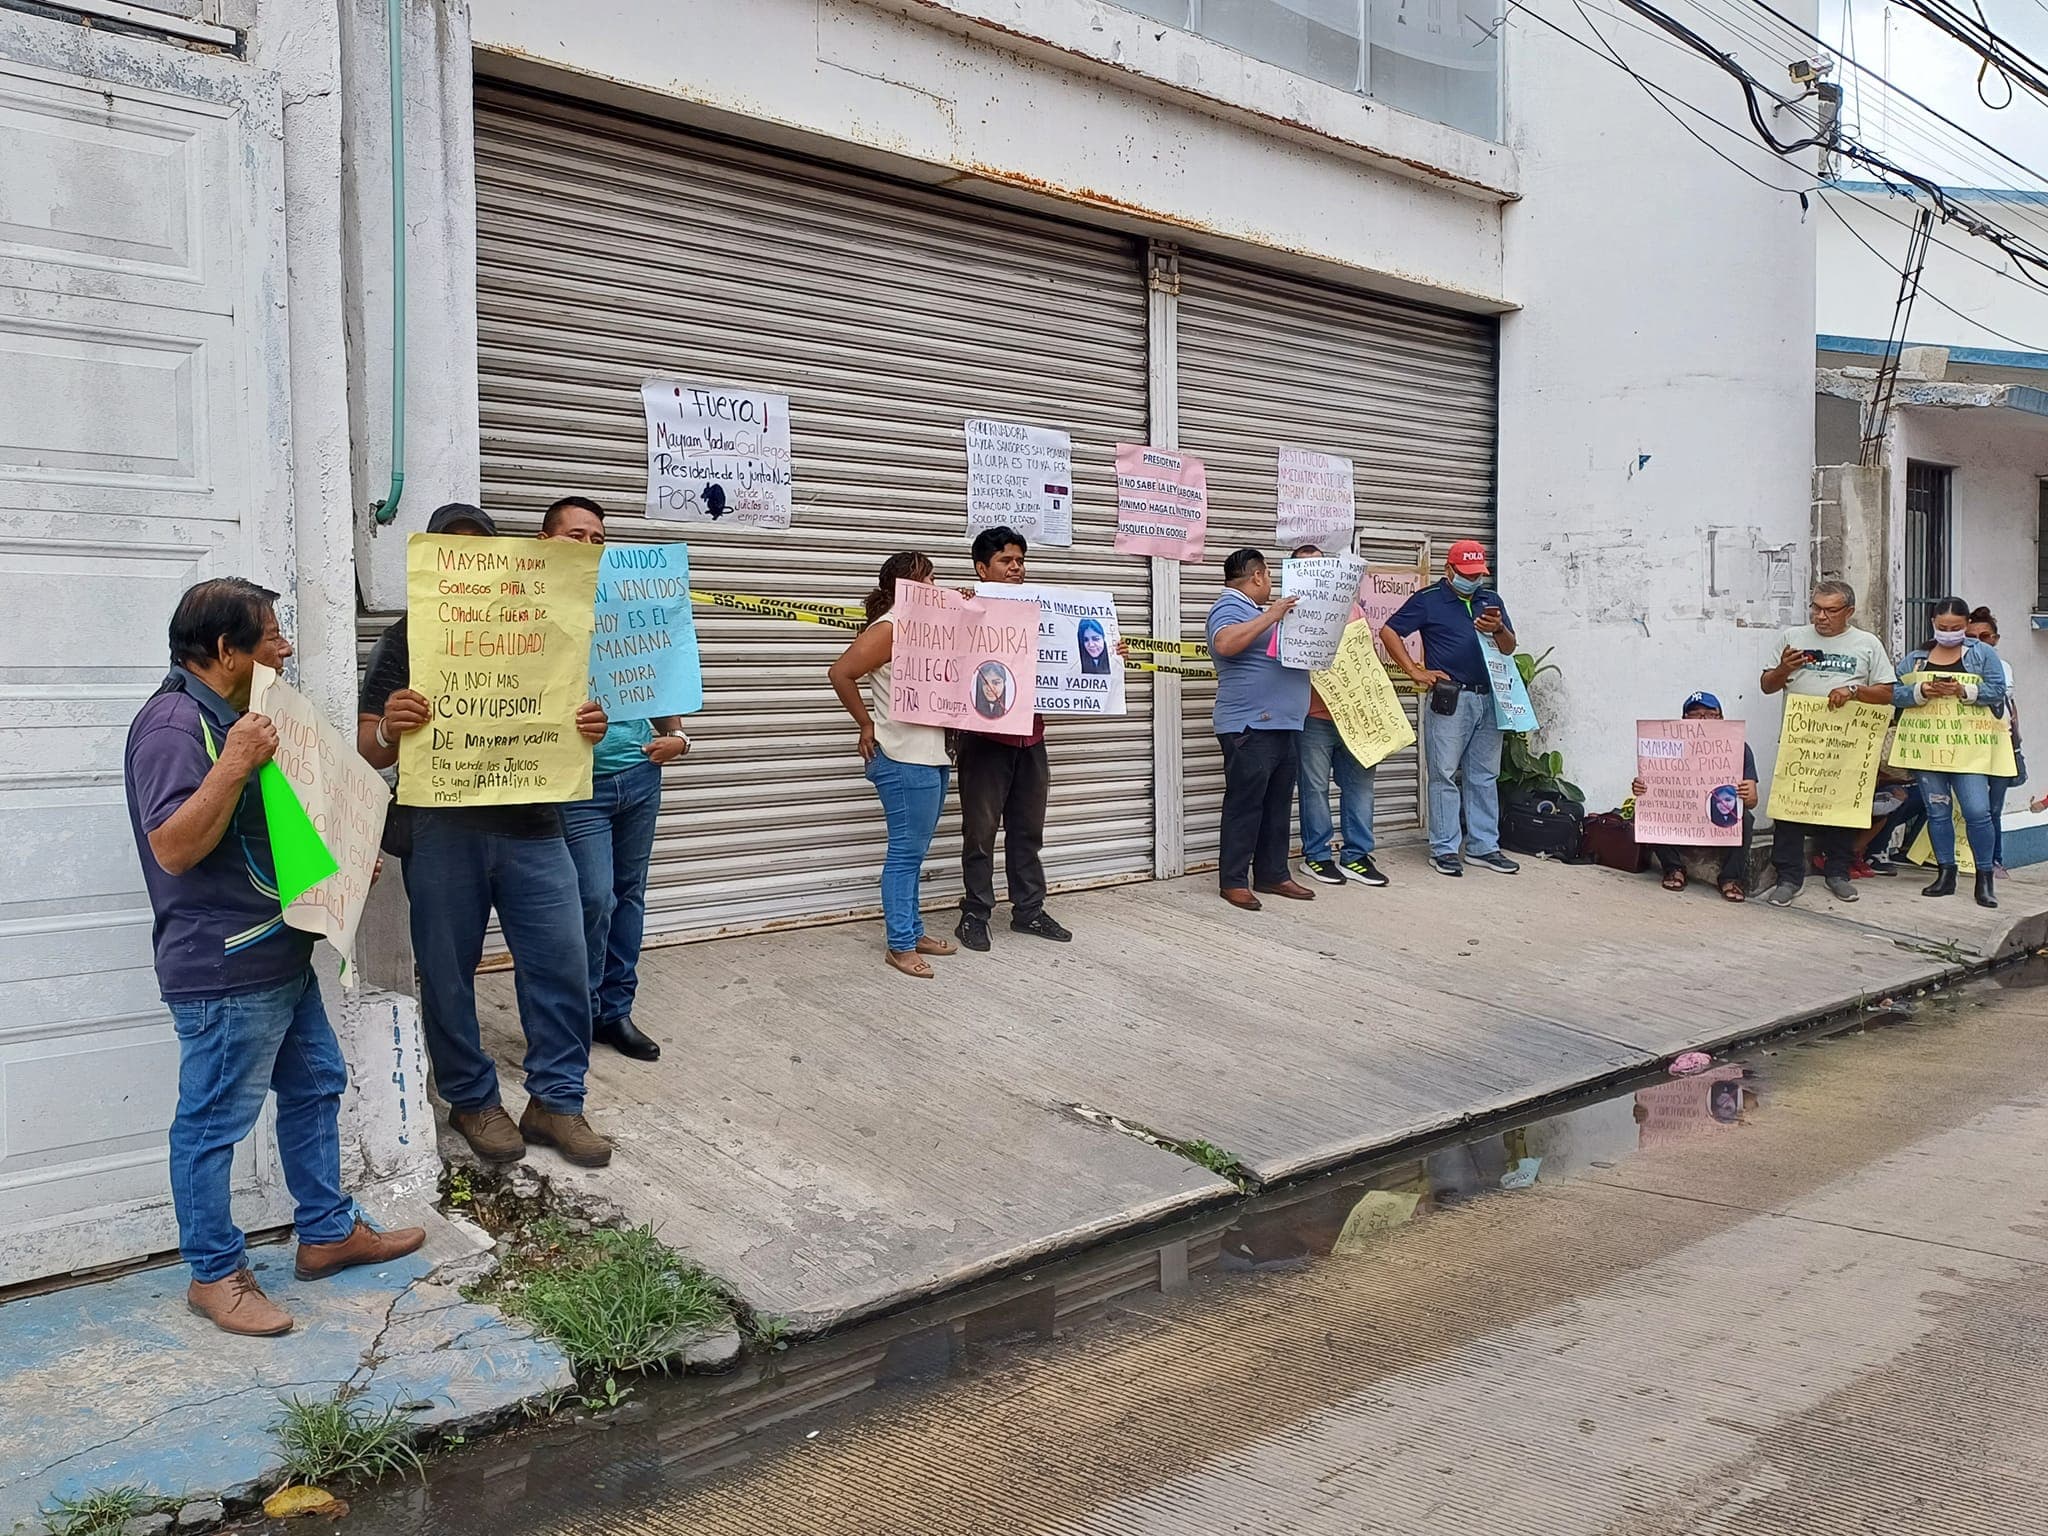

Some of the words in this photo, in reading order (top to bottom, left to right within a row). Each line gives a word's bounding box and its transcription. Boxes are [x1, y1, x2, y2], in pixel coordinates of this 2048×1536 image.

[1143, 453, 1180, 469] PRESIDENTA
[1125, 479, 1135, 488] NO
[1136, 480, 1156, 490] SABE
[1158, 483, 1166, 491] LA
[1167, 484, 1177, 494] LEY
[659, 486, 701, 515] POR
[1150, 503, 1167, 513] HAGA
[1156, 527, 1164, 535] EN
[438, 547, 509, 572] MAYRAM
[608, 548, 667, 569] UNIDOS
[534, 581, 546, 595] SE
[614, 577, 686, 601] VENCIDOS
[1054, 602, 1113, 617] INMEDIATA
[595, 612, 618, 634] HOY
[628, 610, 646, 629] ES
[652, 607, 668, 626] EL
[897, 619, 955, 650] MAIRAM
[966, 626, 1028, 654] YADIRA
[596, 630, 672, 661] MAÑANA
[609, 663, 657, 688] YADIRA
[892, 656, 959, 683] GALLEGOS
[440, 670, 459, 691] YA
[497, 673, 520, 689] MAS
[1065, 678, 1108, 690] YADIRA
[619, 685, 656, 705] PIÑA
[894, 686, 920, 712] PIÑA
[1073, 698, 1100, 709] PIÑA
[433, 727, 454, 751] DE
[1662, 723, 1706, 740] FUERA
[1946, 734, 1970, 745] ESTAR
[1640, 741, 1682, 757] MAIRAM
[1688, 740, 1732, 756] YADIRA
[1931, 749, 1956, 763] LEY
[1699, 757, 1731, 771] PIÑA
[451, 776, 470, 788] una
